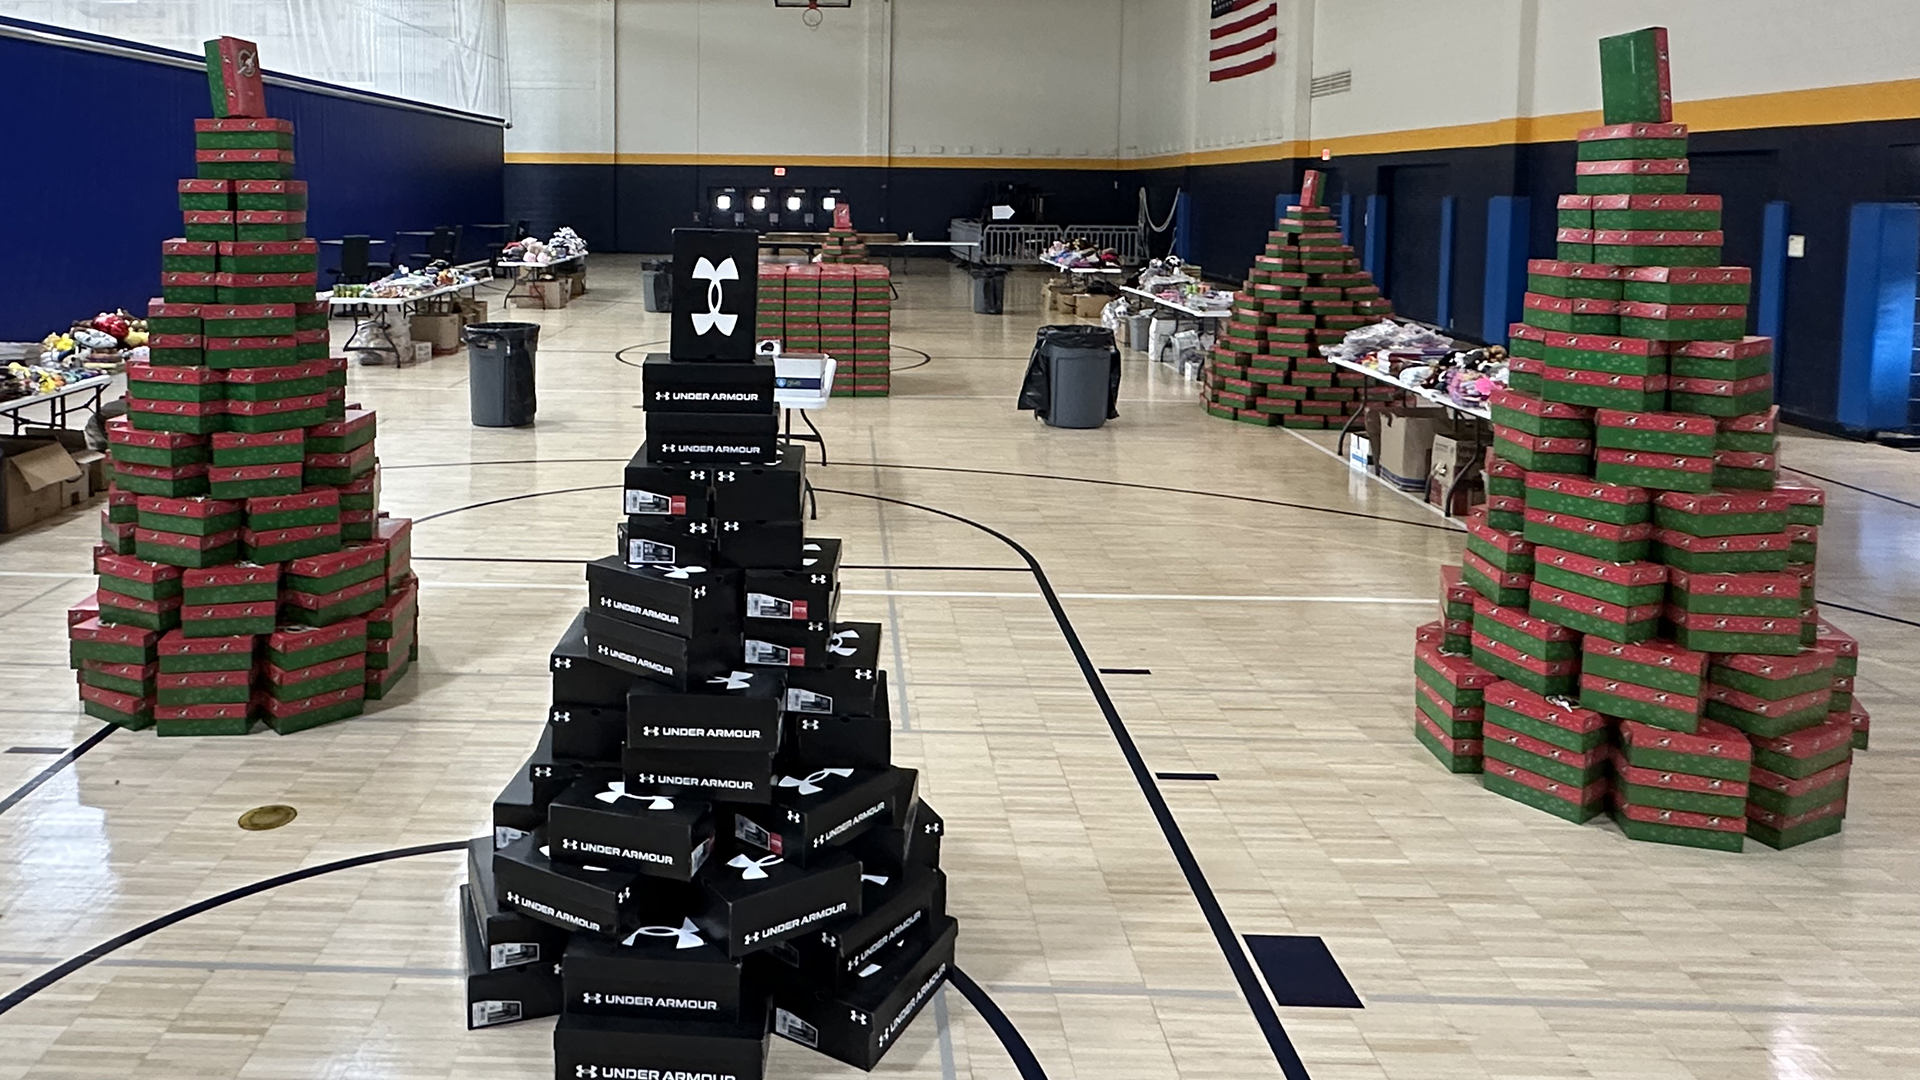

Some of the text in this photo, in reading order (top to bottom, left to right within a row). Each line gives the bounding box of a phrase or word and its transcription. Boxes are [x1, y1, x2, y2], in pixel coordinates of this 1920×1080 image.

[673, 392, 759, 401] UNDER ARMOUR
[678, 445, 761, 454] UNDER ARMOUR
[613, 601, 679, 625] UNDER ARMOUR
[610, 649, 673, 676] UNDER ARMOUR
[662, 727, 761, 739] UNDER ARMOUR
[658, 775, 753, 790] UNDER ARMOUR
[826, 801, 885, 841] UNDER ARMOUR
[580, 842, 674, 865] UNDER ARMOUR
[521, 897, 601, 932] UNDER ARMOUR
[762, 902, 847, 939] UNDER ARMOUR
[860, 910, 921, 961] UNDER ARMOUR
[605, 994, 717, 1010] UNDER ARMOUR
[889, 962, 946, 1033] UNDER ARMOUR
[602, 1066, 660, 1080] UNDER
